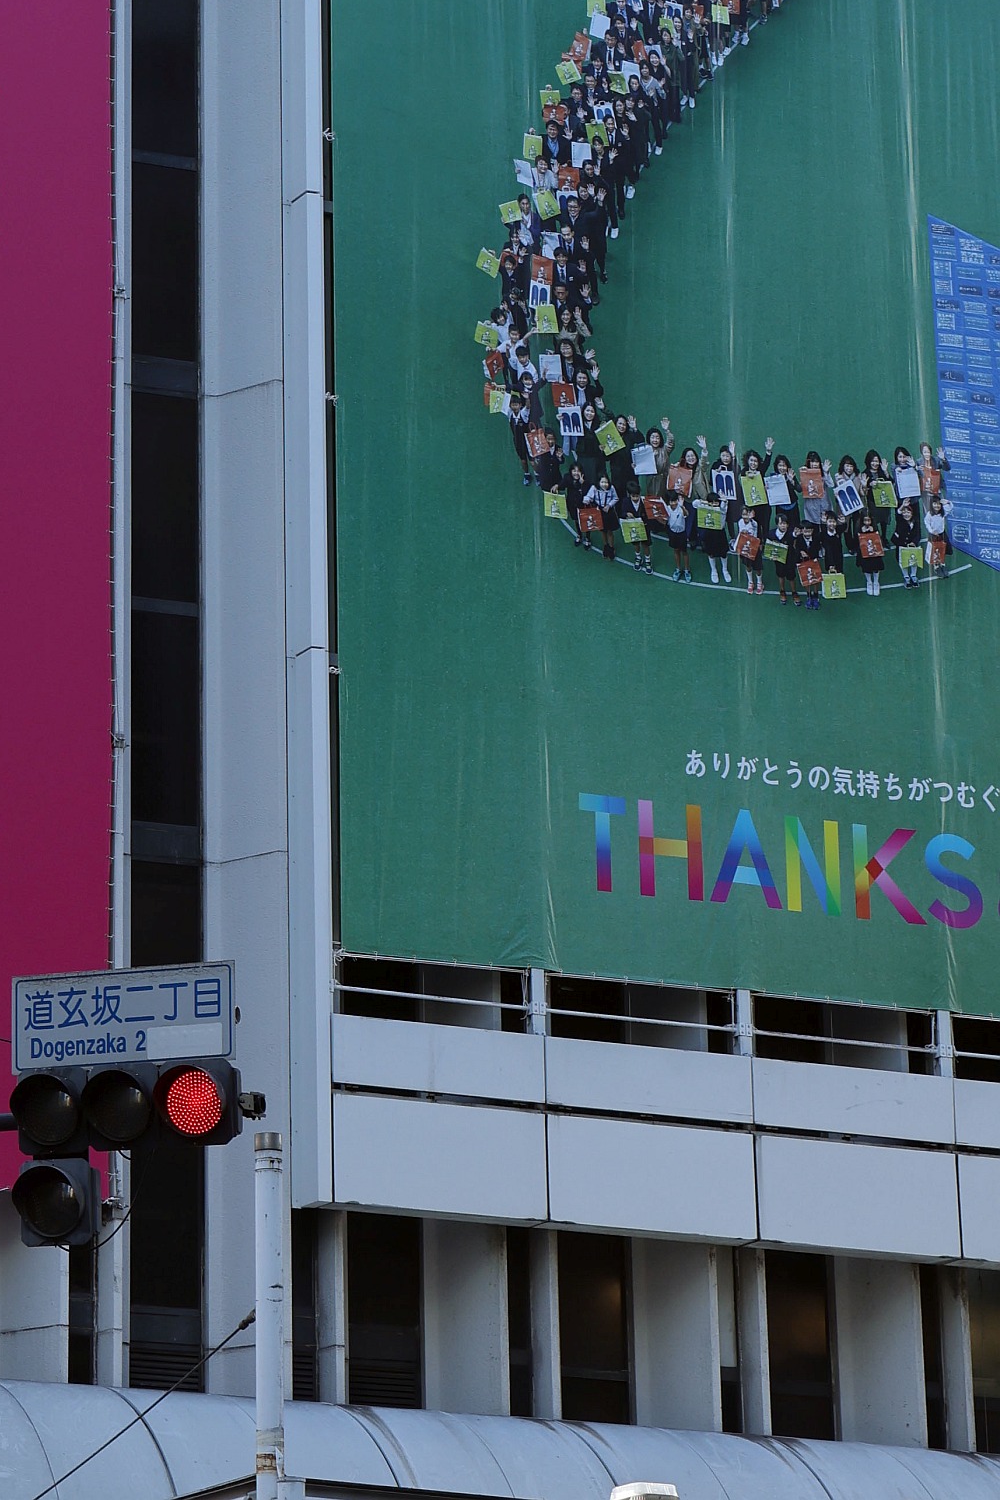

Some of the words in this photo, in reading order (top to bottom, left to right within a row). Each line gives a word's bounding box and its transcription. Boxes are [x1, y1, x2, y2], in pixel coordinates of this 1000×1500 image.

[685, 749, 1000, 813] ありがとうの気持ちがつむぐ
[578, 792, 984, 930] THANKS
[24, 978, 221, 1031] 道玄坂二丁目
[30, 1032, 127, 1062] Dogenzaka
[135, 1030, 147, 1052] 2
